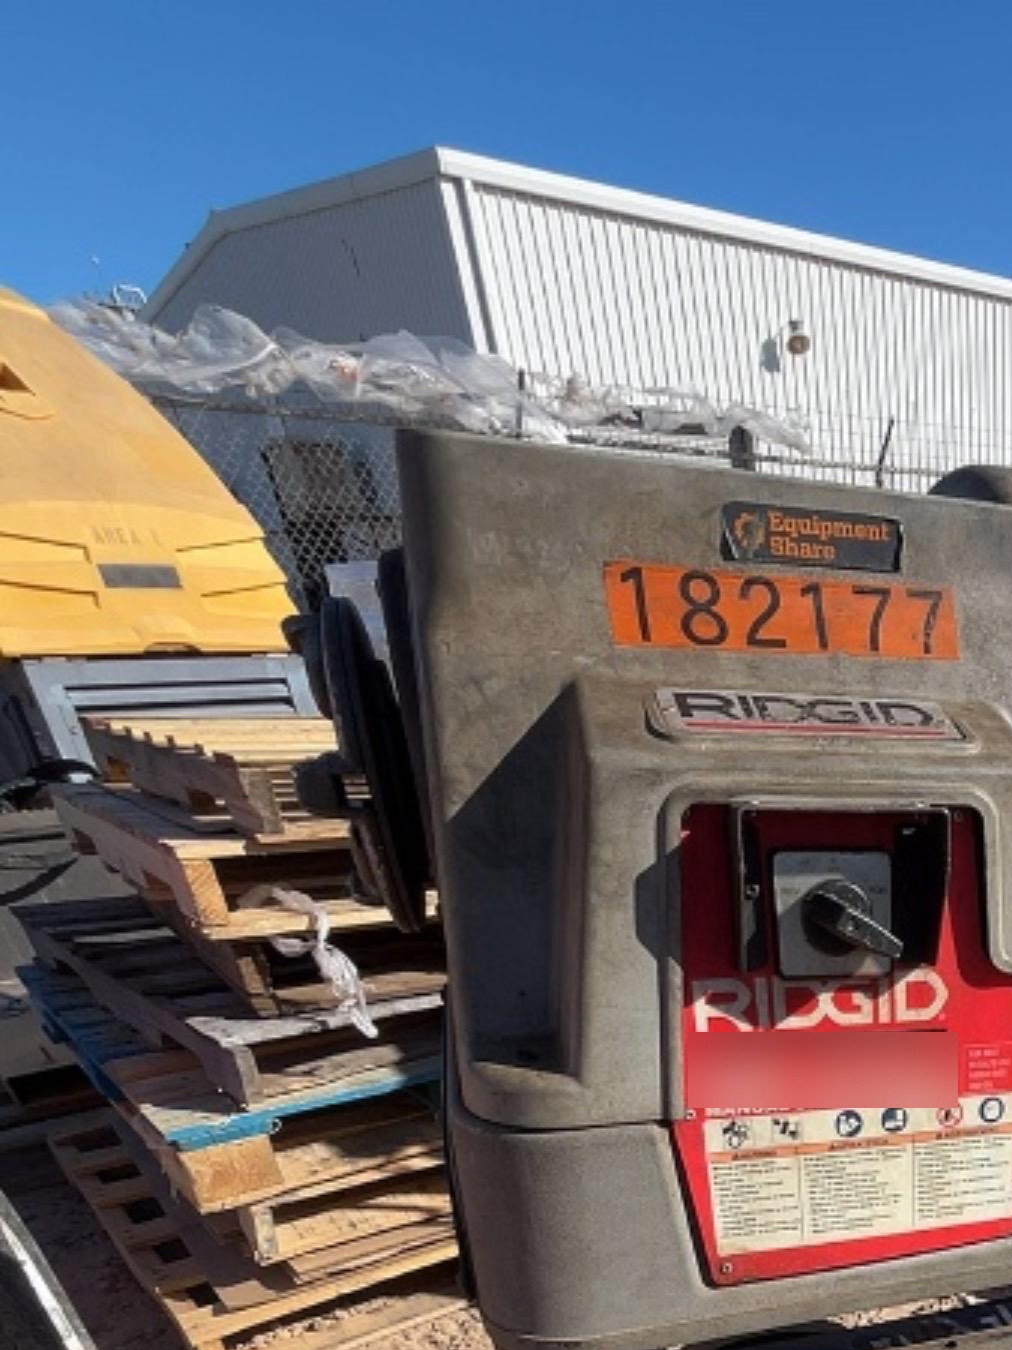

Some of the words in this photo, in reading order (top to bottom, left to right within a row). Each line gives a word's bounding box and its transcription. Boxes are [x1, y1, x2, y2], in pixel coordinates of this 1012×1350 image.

[769, 509, 892, 543] Equipment
[769, 535, 837, 560] Share
[619, 566, 944, 656] 182177
[673, 692, 934, 727] RIDGID
[692, 963, 948, 1032] RIDGID
